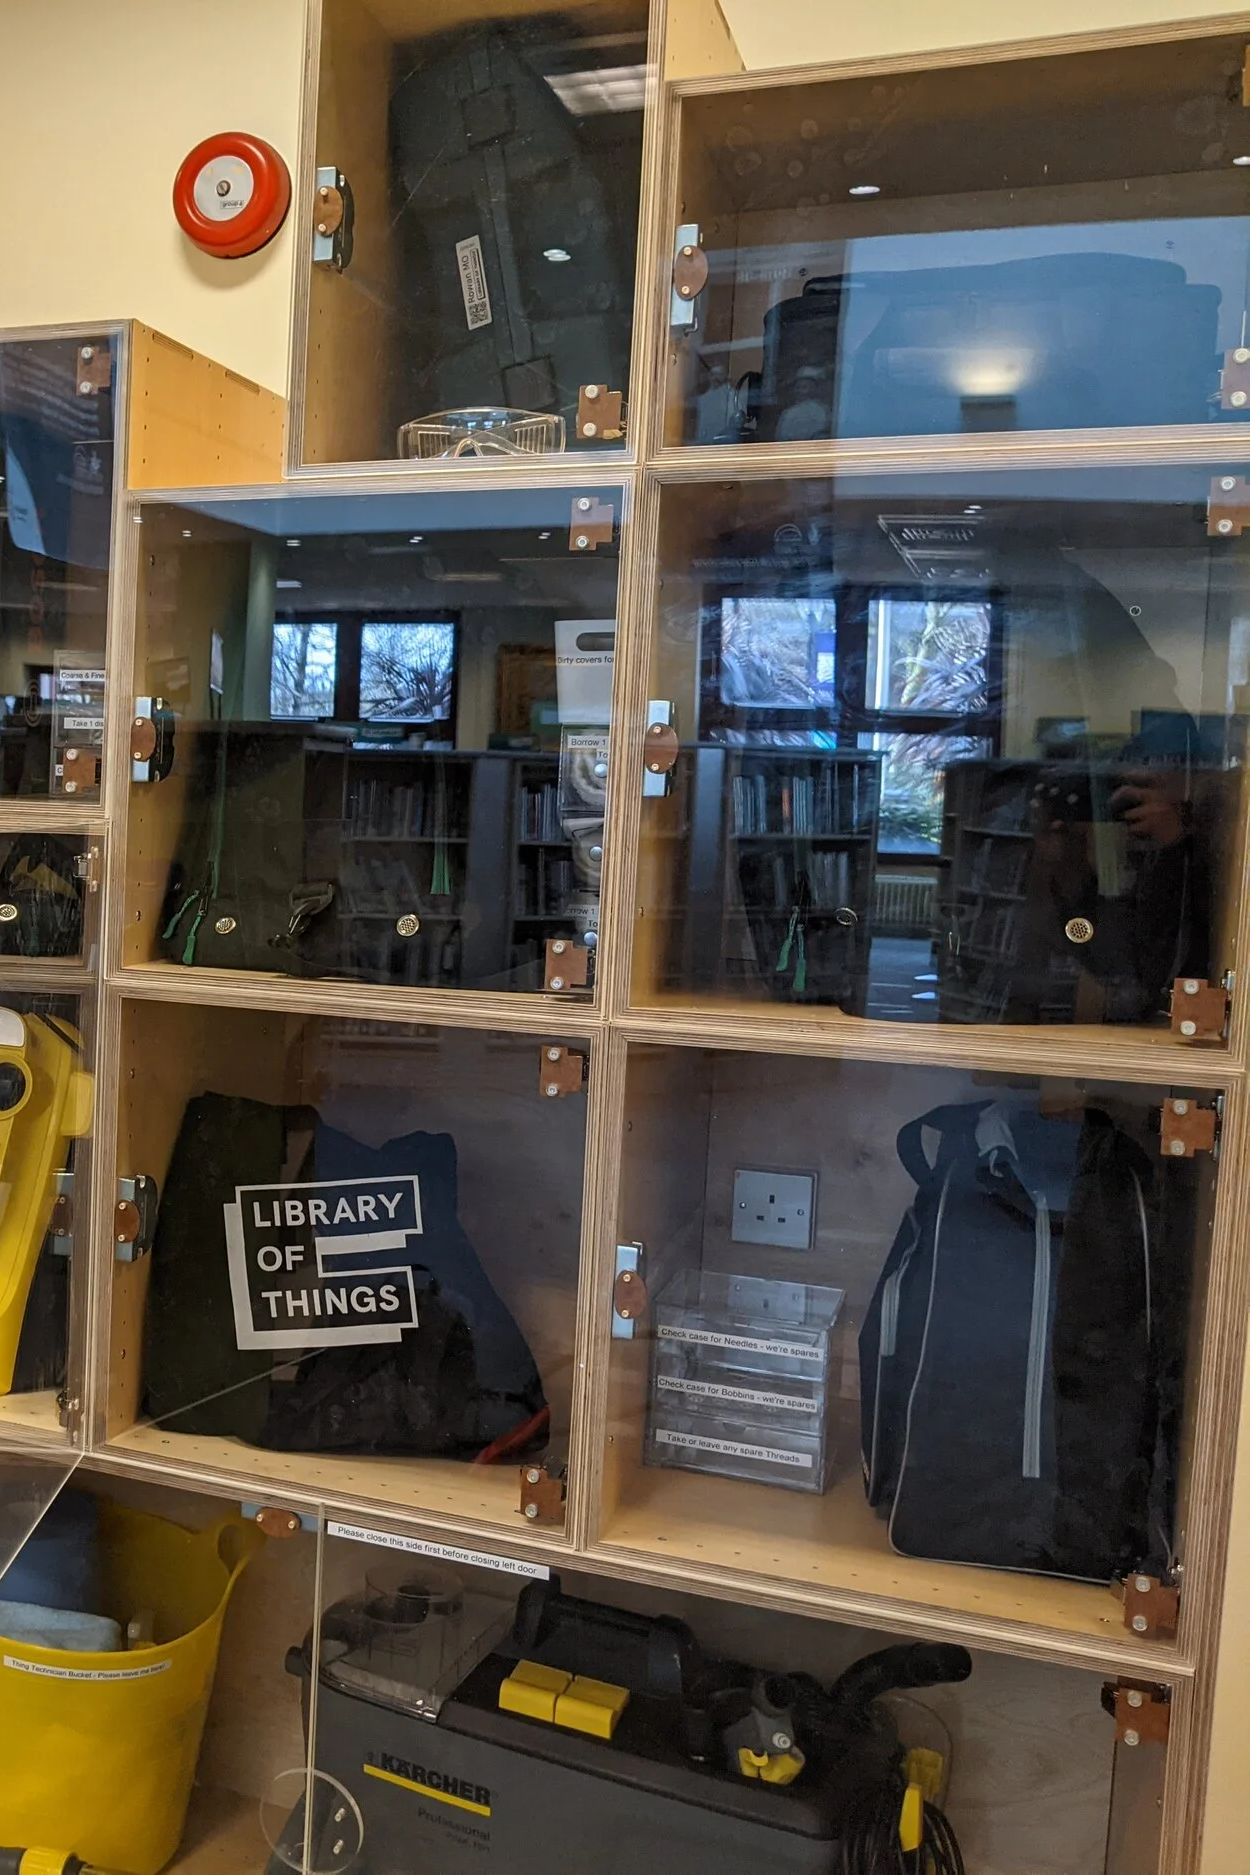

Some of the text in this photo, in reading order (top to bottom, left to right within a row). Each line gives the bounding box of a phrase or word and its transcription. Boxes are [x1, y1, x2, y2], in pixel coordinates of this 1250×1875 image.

[465, 272, 476, 304] Rowan
[571, 738, 600, 746] Borrow
[252, 1192, 403, 1228] LIBRARY
[257, 1245, 305, 1272] OF
[261, 1284, 400, 1318] THINGS
[661, 1327, 687, 1338] Check
[689, 1333, 708, 1341] case
[710, 1335, 722, 1343] for
[724, 1338, 758, 1349] Needles
[766, 1345, 788, 1354] we're
[790, 1348, 819, 1358] spares
[658, 1378, 685, 1389] Check
[686, 1384, 705, 1392] case
[707, 1385, 719, 1394] for
[721, 1388, 755, 1400] Bobbins
[762, 1396, 785, 1405] we're
[787, 1400, 816, 1410] spares
[667, 1433, 687, 1443] Take
[698, 1439, 721, 1450] leave
[722, 1445, 738, 1454] any
[740, 1447, 764, 1457] spare
[766, 1450, 800, 1463] Threads
[338, 1526, 537, 1575] Please close this side first before closing left door
[12, 1660, 29, 1670] Thing
[31, 1664, 67, 1676] Technician
[68, 1670, 92, 1678] Bucket
